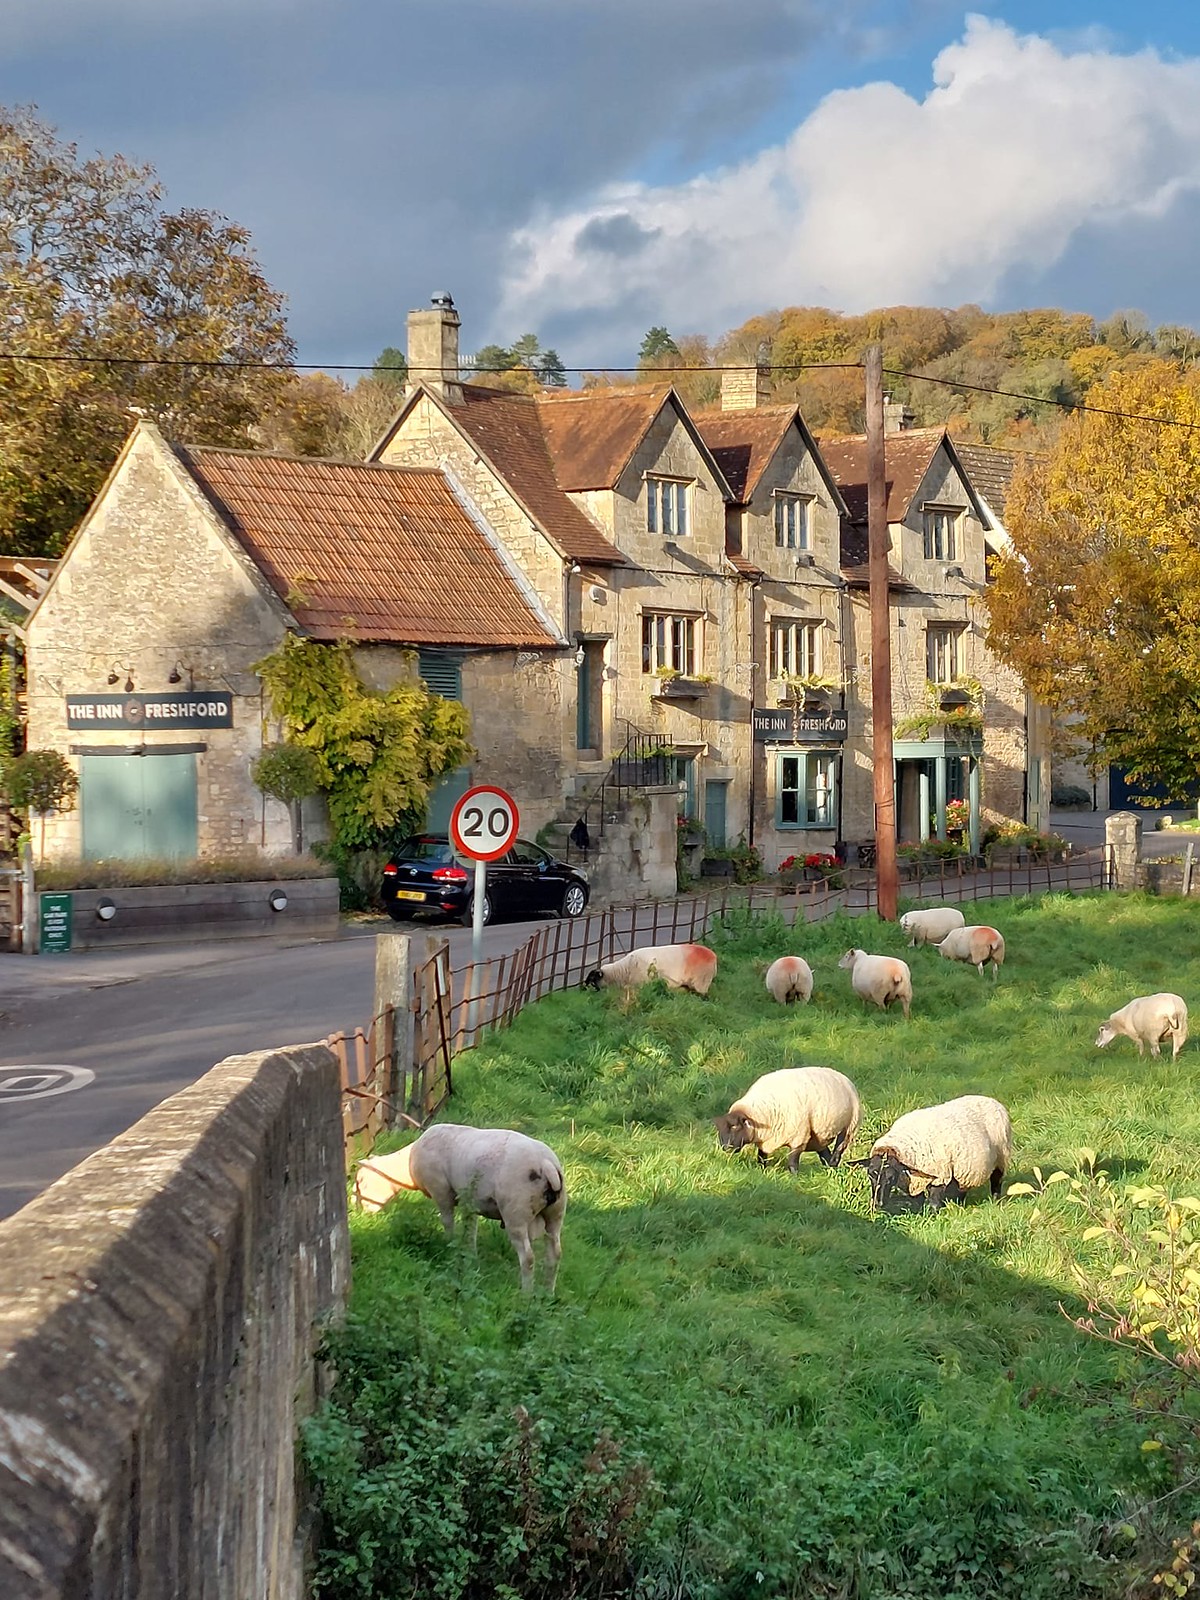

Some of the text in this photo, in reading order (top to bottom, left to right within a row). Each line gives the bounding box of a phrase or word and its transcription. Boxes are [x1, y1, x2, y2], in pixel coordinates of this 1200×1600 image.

[68, 702, 228, 719] THE INN FRESHFORD
[754, 717, 847, 731] THE INN FRESHFORD
[464, 807, 509, 837] 20
